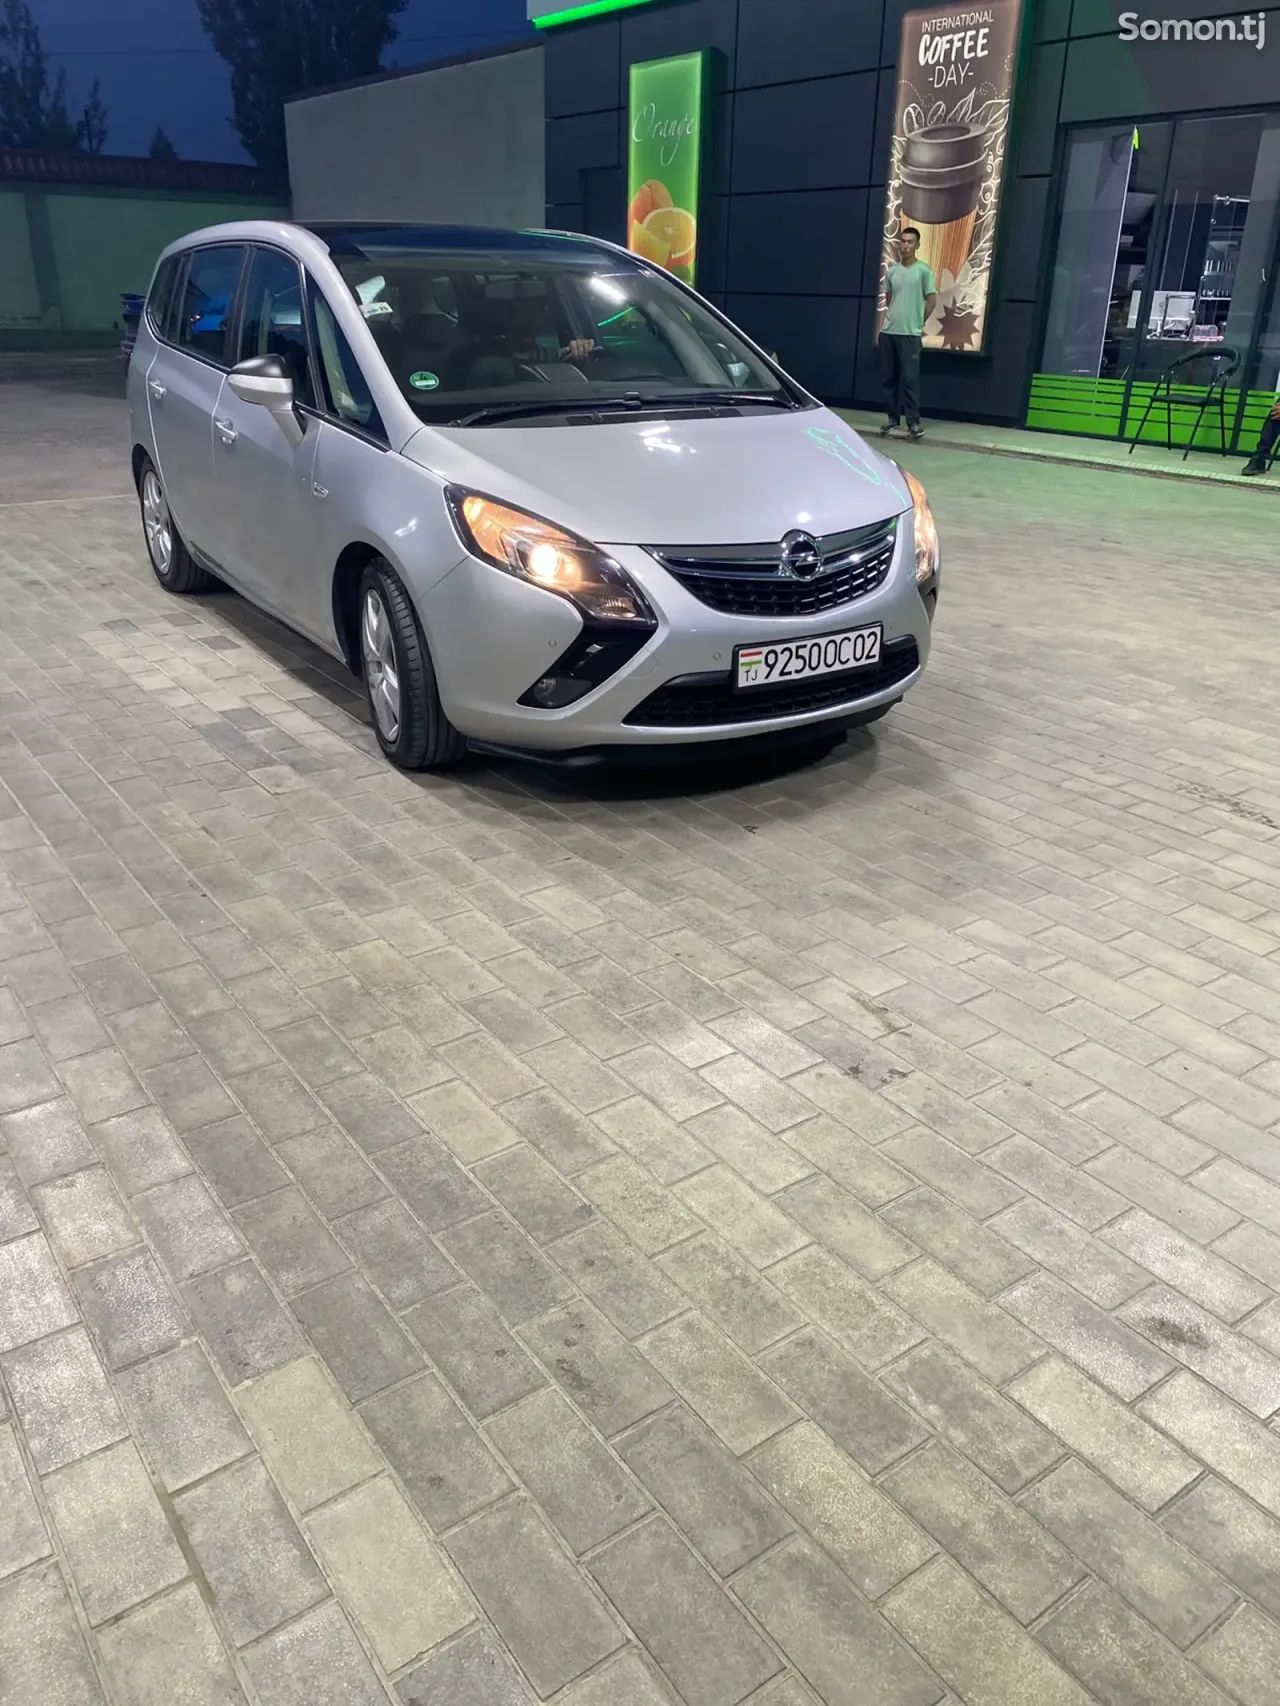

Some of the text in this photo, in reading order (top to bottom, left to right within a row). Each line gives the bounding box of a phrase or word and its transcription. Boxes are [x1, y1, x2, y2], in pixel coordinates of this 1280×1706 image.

[921, 10, 994, 33] INTERNATIONAL
[918, 28, 990, 66] COFFEE
[632, 102, 694, 167] Orange
[744, 669, 758, 682] TJ
